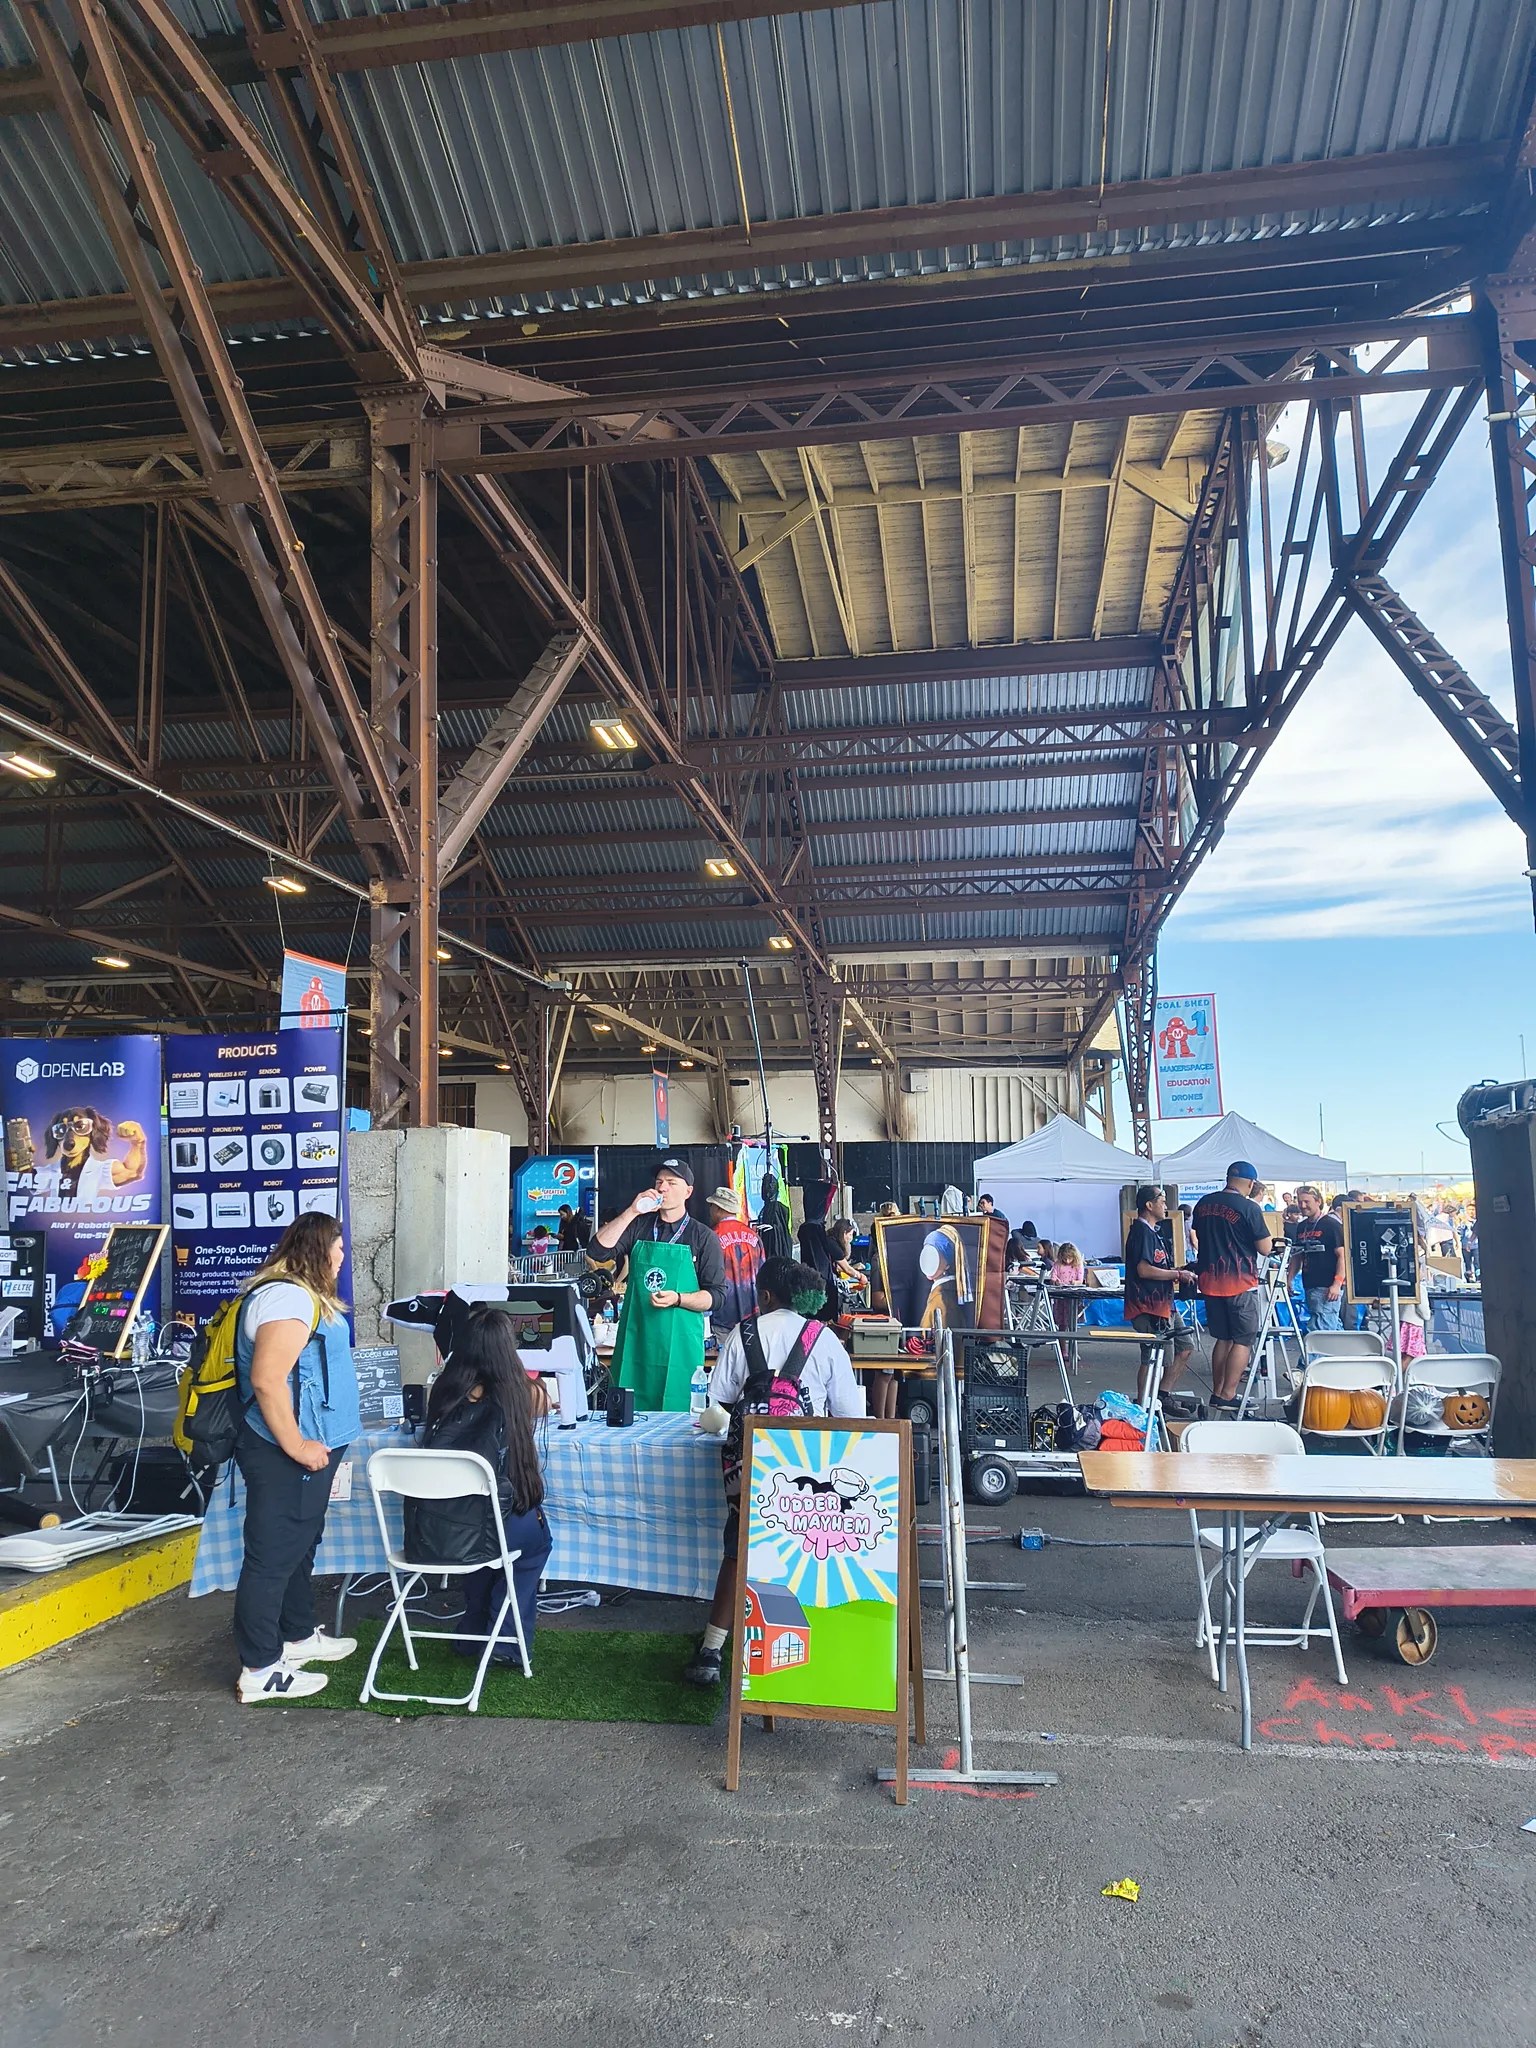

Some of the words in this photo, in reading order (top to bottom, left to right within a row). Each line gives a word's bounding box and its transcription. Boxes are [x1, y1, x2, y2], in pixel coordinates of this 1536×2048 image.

[1157, 1001, 1181, 1010] COAL
[1184, 998, 1210, 1008] SHED
[1191, 1009, 1206, 1036] 1
[217, 1043, 278, 1059] PRODUCTS
[41, 1062, 126, 1078] OPENELAB
[258, 1068, 281, 1076] SENSOR
[1159, 1063, 1215, 1073] MAKERSPACES
[183, 1071, 201, 1079] BOARD
[1166, 1078, 1211, 1087] EDUCATION
[1171, 1093, 1204, 1102] DRONES
[177, 1126, 206, 1134] EQUIPMENT
[60, 1178, 72, 1190] &
[219, 1182, 242, 1190] DISPLAY
[302, 1176, 338, 1186] ACCESSORY
[9, 1194, 152, 1222] FABULOUS
[194, 1246, 237, 1255] One-Stop
[238, 1244, 268, 1253] Online
[1360, 1240, 1368, 1265] VIZIO
[194, 1257, 217, 1265] AIoT
[224, 1255, 262, 1264] Robotics
[202, 1270, 230, 1278] products
[189, 1279, 221, 1287] beginners
[780, 1495, 839, 1512] UDDER
[791, 1513, 871, 1535] MAYHEM
[262, 1671, 295, 1692] N
